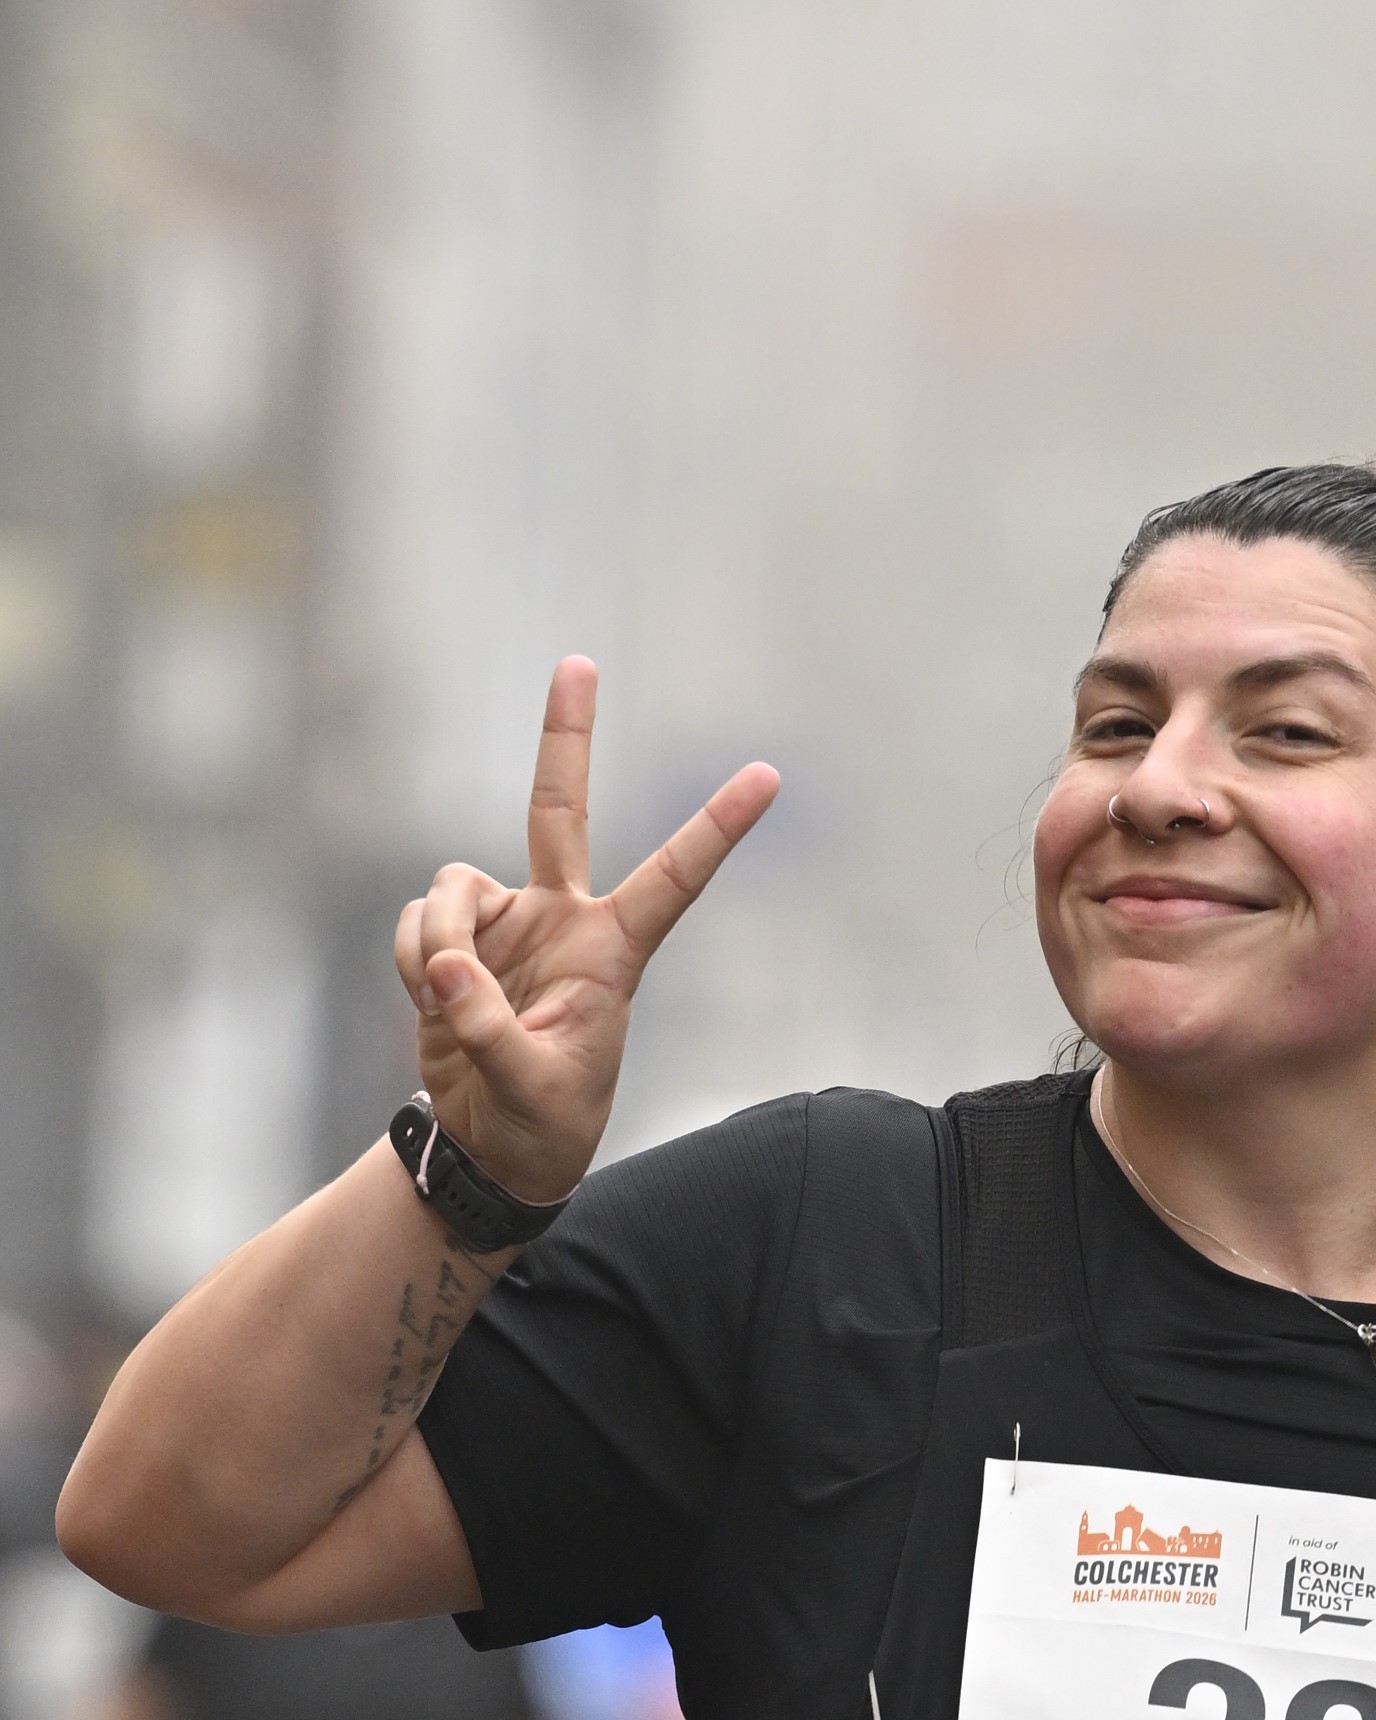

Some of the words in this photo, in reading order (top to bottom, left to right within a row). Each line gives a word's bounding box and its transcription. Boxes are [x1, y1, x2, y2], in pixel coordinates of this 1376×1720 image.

[1288, 1535, 1300, 1547] in
[1302, 1538, 1323, 1549] aid
[1325, 1541, 1339, 1551] of
[1074, 1560, 1219, 1588] COLCHESTER
[1300, 1558, 1365, 1581] ROBIN
[1072, 1588, 1182, 1604] HALF-MARATHON
[1185, 1590, 1217, 1606] 2026
[1298, 1575, 1376, 1599] CANCER
[1297, 1591, 1354, 1612] TRUST
